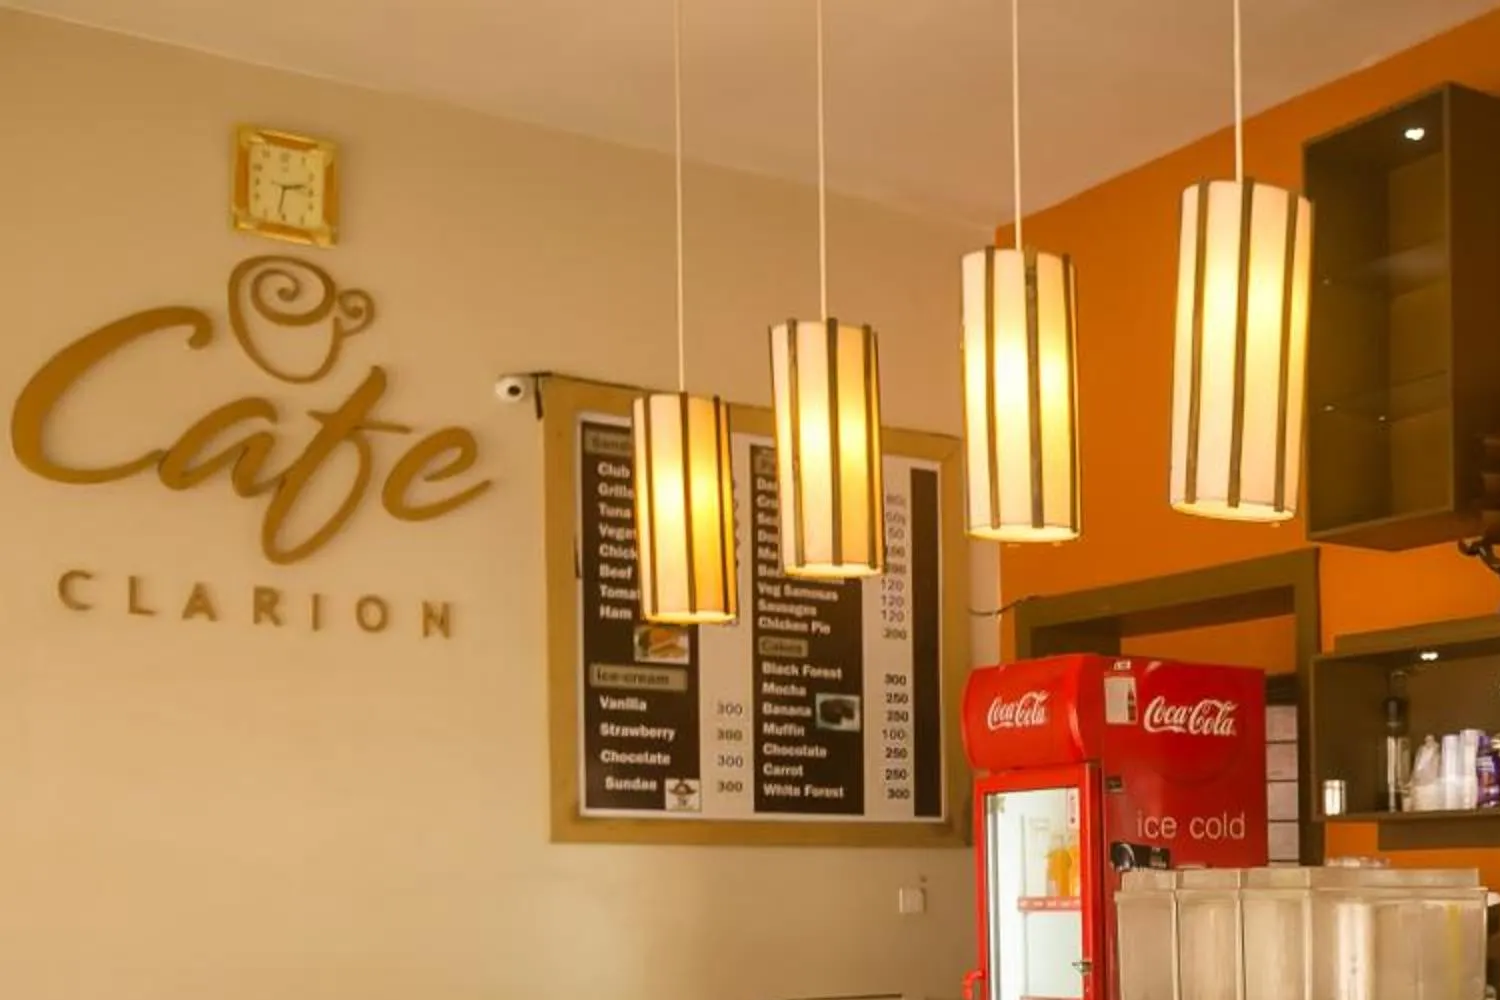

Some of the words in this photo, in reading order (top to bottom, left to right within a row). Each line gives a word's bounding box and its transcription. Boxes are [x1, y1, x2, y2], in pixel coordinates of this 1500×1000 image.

[11, 305, 492, 565] Cafe
[597, 462, 630, 478] Club
[597, 482, 634, 498] Grille
[599, 502, 631, 520] Tuna
[600, 563, 632, 579] Beef
[57, 568, 451, 639] CLARION
[600, 605, 632, 620] Ham
[758, 617, 808, 633] Chicken
[762, 662, 799, 677] Black
[803, 664, 842, 680] Forest
[762, 682, 807, 697] Mocha
[600, 696, 647, 712] Vanilla
[763, 702, 812, 717] Banana
[600, 722, 675, 742] Strawberry
[763, 722, 805, 737] Muffin
[601, 750, 671, 765] Chocolate
[762, 743, 827, 758] Chocolate
[763, 763, 803, 777] Carrot
[605, 776, 657, 791] Sundae
[763, 783, 800, 797] White
[804, 784, 844, 799] Forest
[1136, 811, 1177, 840] ice
[1189, 812, 1246, 840] cold
